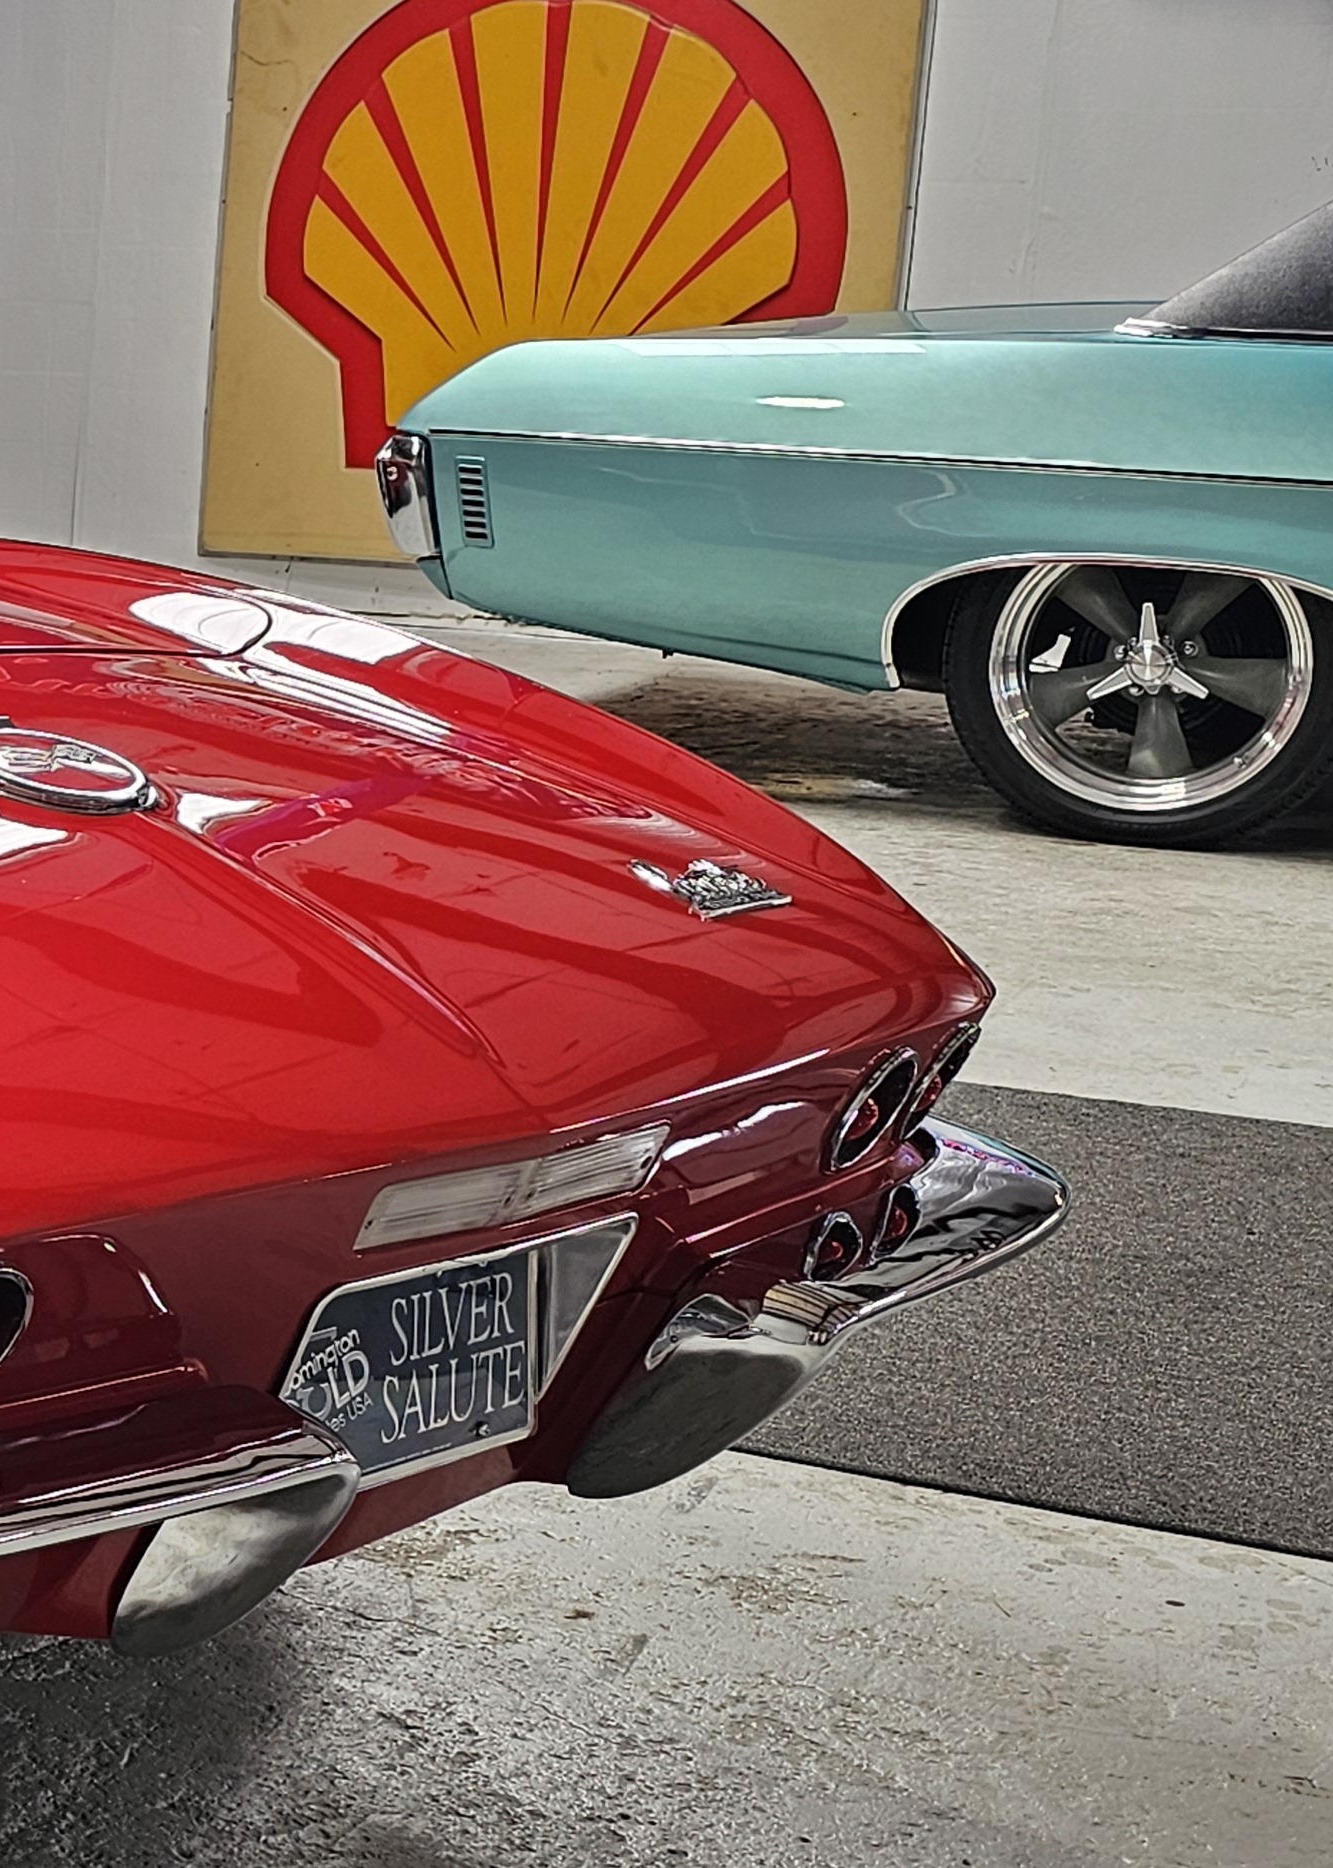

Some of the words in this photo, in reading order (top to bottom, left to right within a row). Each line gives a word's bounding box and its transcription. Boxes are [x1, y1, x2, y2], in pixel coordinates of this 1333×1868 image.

[389, 1271, 515, 1367] SILVER
[283, 1328, 361, 1398] omington
[286, 1350, 370, 1422] OLD
[380, 1340, 526, 1444] SALUTE
[346, 1391, 374, 1421] USA
